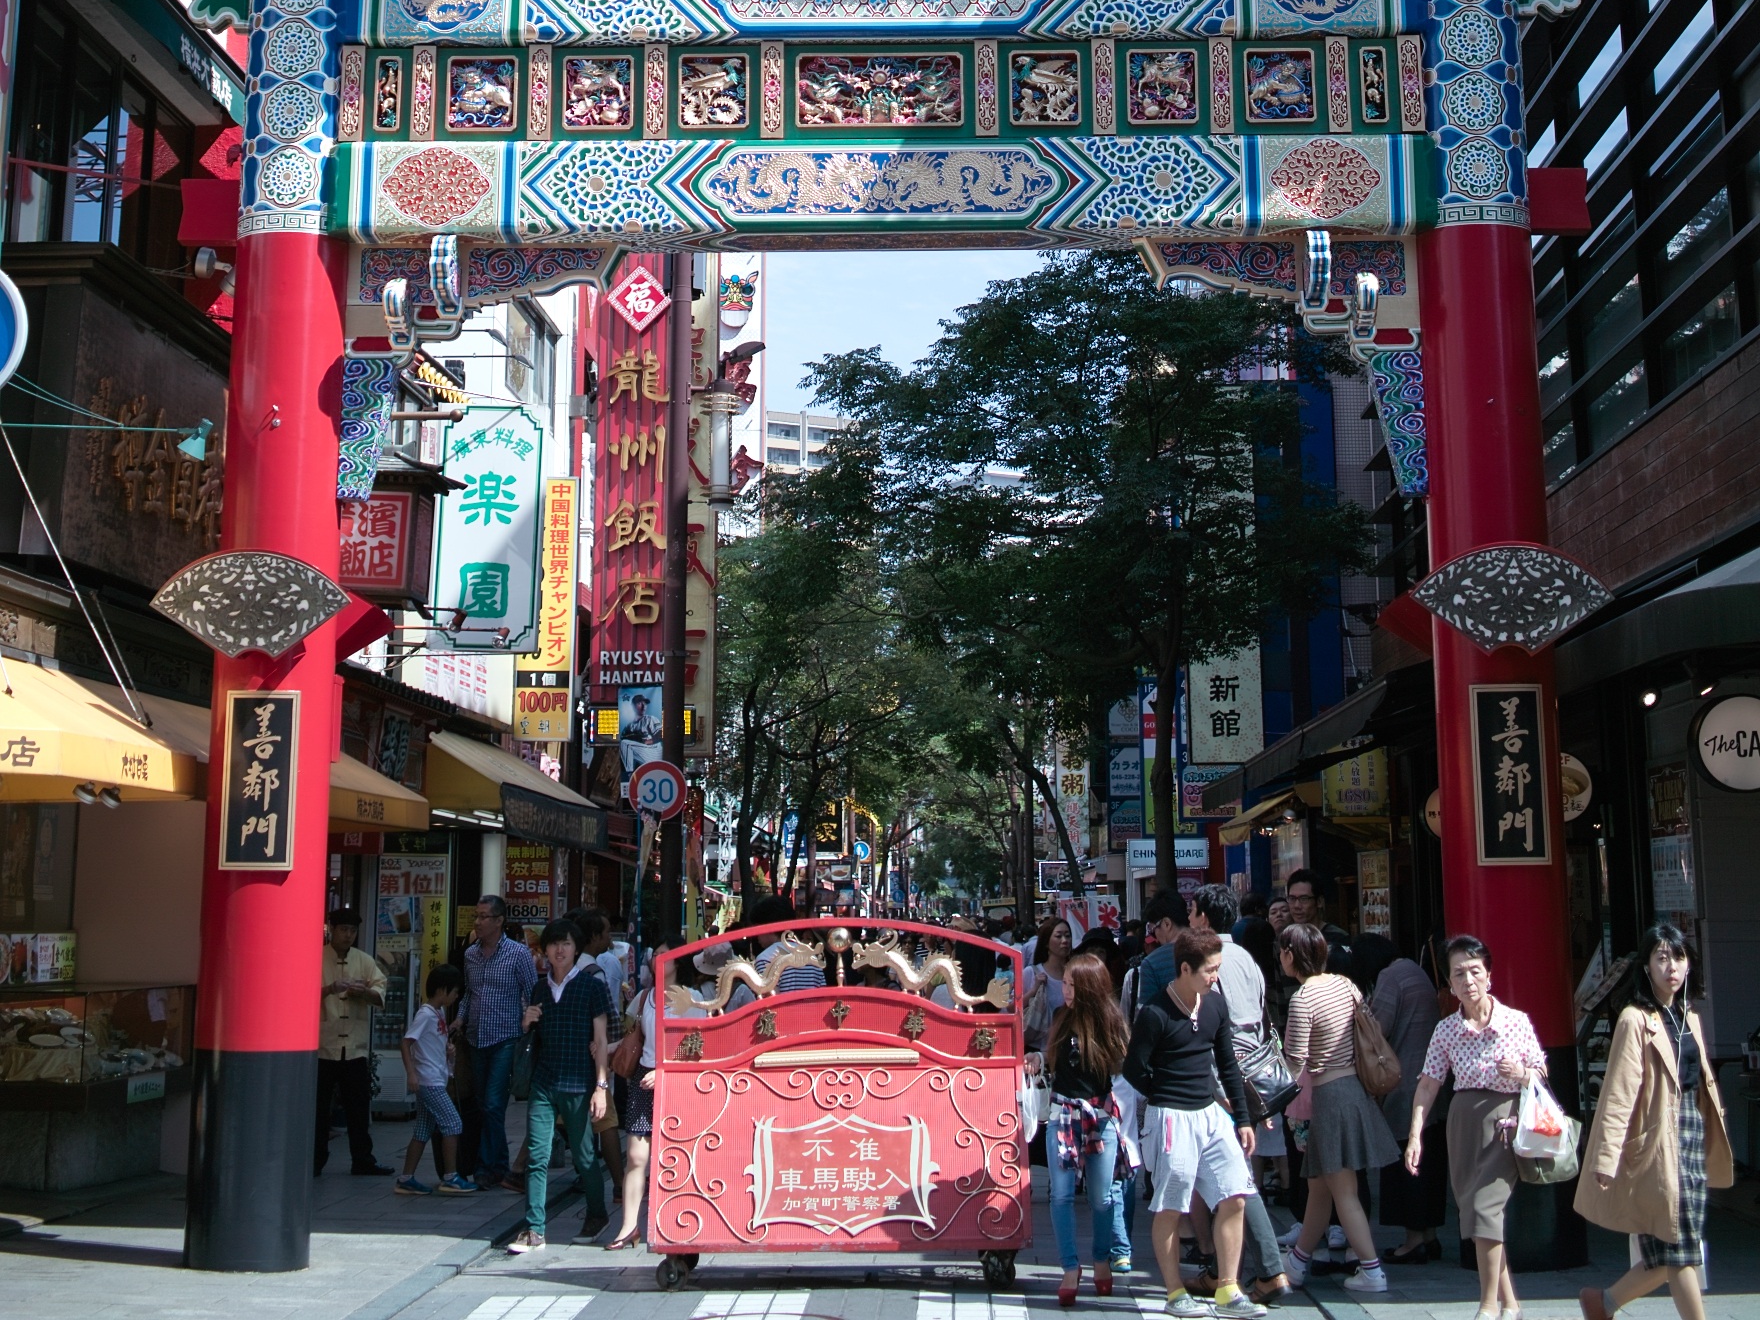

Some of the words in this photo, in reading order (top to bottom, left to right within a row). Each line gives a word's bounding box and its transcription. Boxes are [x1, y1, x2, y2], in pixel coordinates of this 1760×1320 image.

[625, 281, 656, 315] 福
[451, 427, 534, 462] 廣東料理
[597, 349, 669, 625] 龍州飯店
[458, 471, 520, 618] 楽園
[546, 483, 571, 666] 中国料理世界チャンピオン
[600, 650, 665, 666] RYUSYU
[517, 691, 568, 713] 100円
[1209, 675, 1241, 738] 新館
[643, 778, 673, 803] 30
[1133, 849, 1157, 858] CHIN
[1173, 849, 1203, 859] QUARE
[506, 905, 548, 918] 1680円
[427, 901, 442, 970] 横浜中華街
[801, 1138, 881, 1162] 不准
[774, 1167, 911, 1192] 車馬駛入
[781, 1196, 901, 1211] 加賀町警察署
